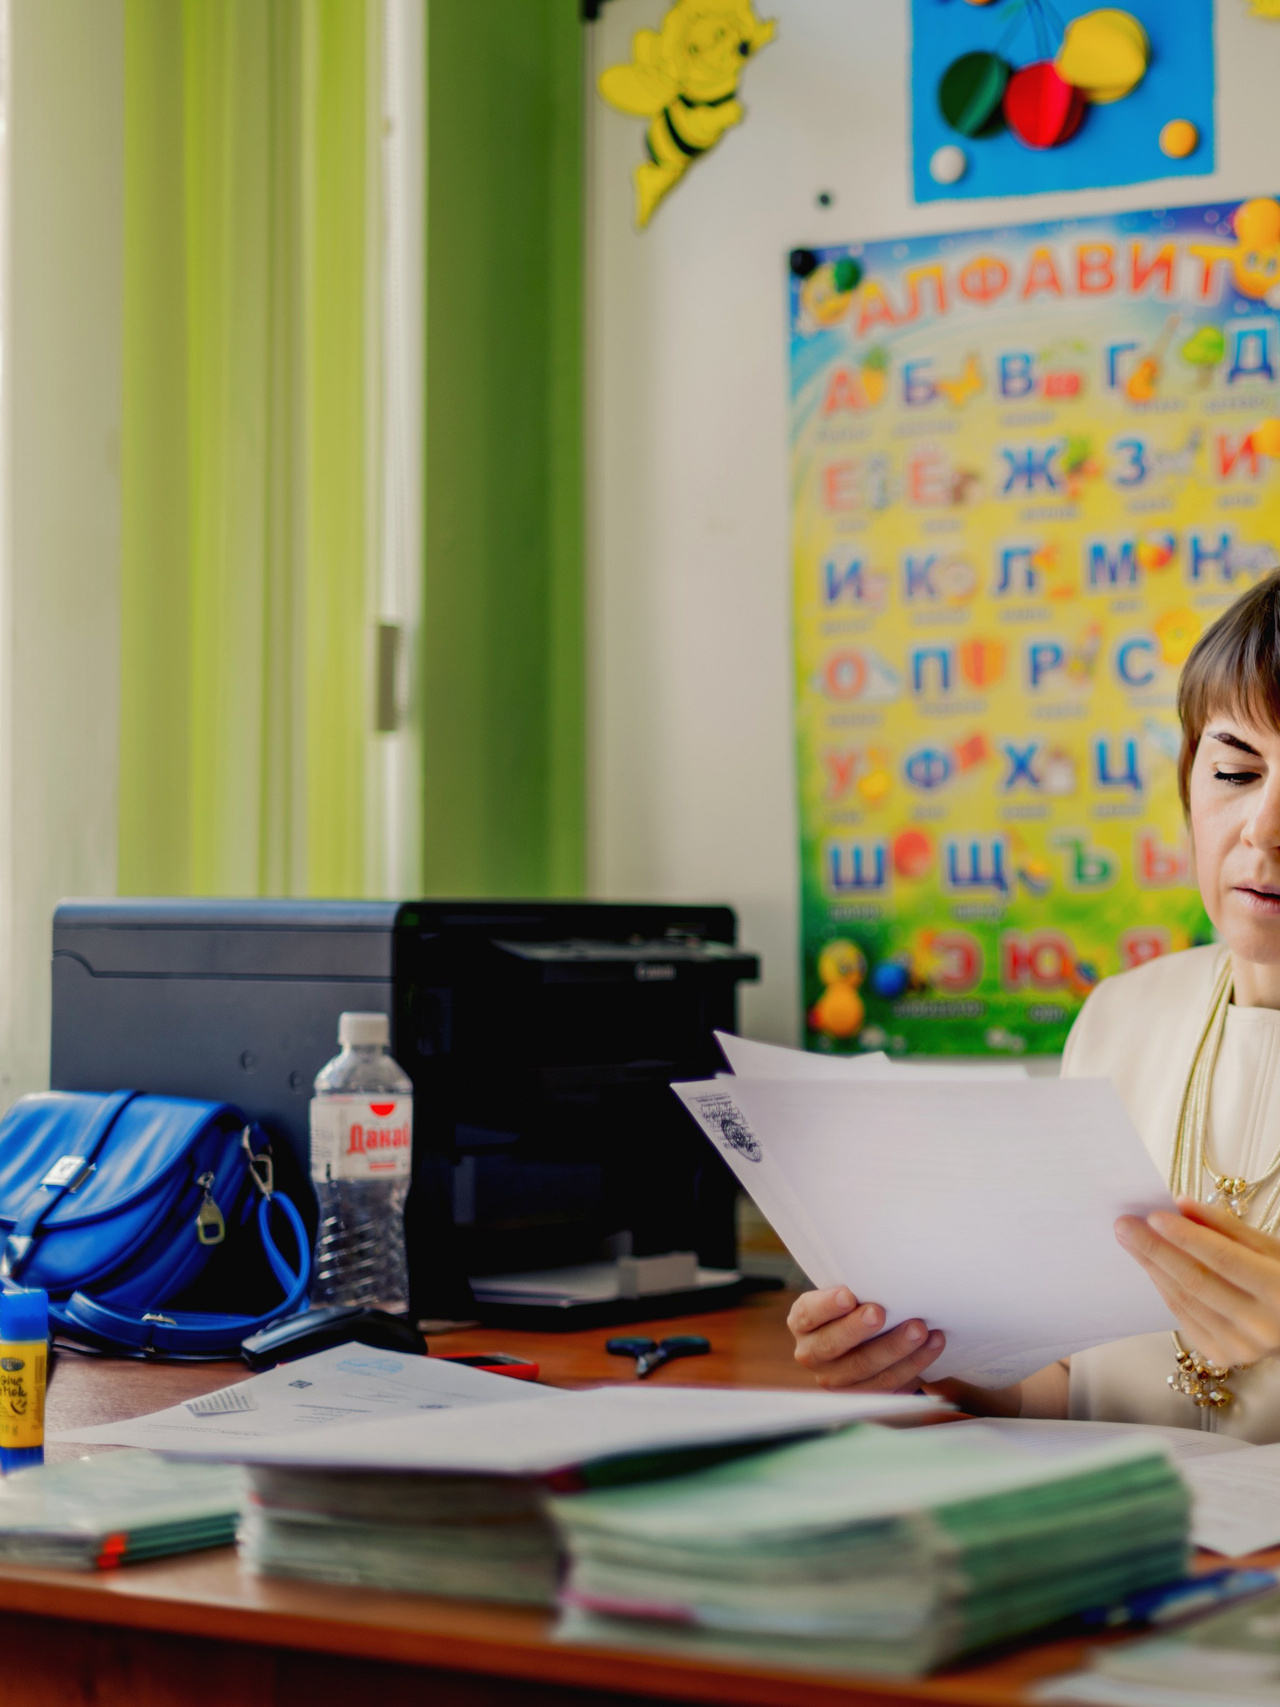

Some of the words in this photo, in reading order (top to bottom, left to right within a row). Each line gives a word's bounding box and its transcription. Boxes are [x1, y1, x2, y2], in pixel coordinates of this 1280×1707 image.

[858, 243, 1238, 336] АЛФАВИТ
[823, 370, 864, 416] А
[903, 359, 937, 405] Б
[999, 352, 1035, 398] В
[1109, 344, 1138, 388] Г
[1227, 329, 1275, 385] Д
[825, 461, 860, 508] Е
[1002, 442, 1059, 493] Ж
[1115, 439, 1147, 487] З
[1218, 433, 1258, 478] И
[905, 556, 936, 598] К
[998, 545, 1036, 595] Л
[1088, 542, 1139, 588] М
[1190, 533, 1232, 580] Н
[825, 650, 867, 700] О
[912, 647, 951, 692] П
[1029, 643, 1063, 688] Р
[1116, 639, 1155, 687] С
[825, 751, 857, 800] У
[905, 744, 952, 789] Ф
[1003, 742, 1041, 790] Х
[1096, 738, 1143, 793] Ц
[830, 842, 885, 891] Ш
[948, 840, 1008, 894] Щ
[1053, 837, 1111, 885] Ъ
[932, 935, 978, 989] Э
[1007, 935, 1071, 988] Ю
